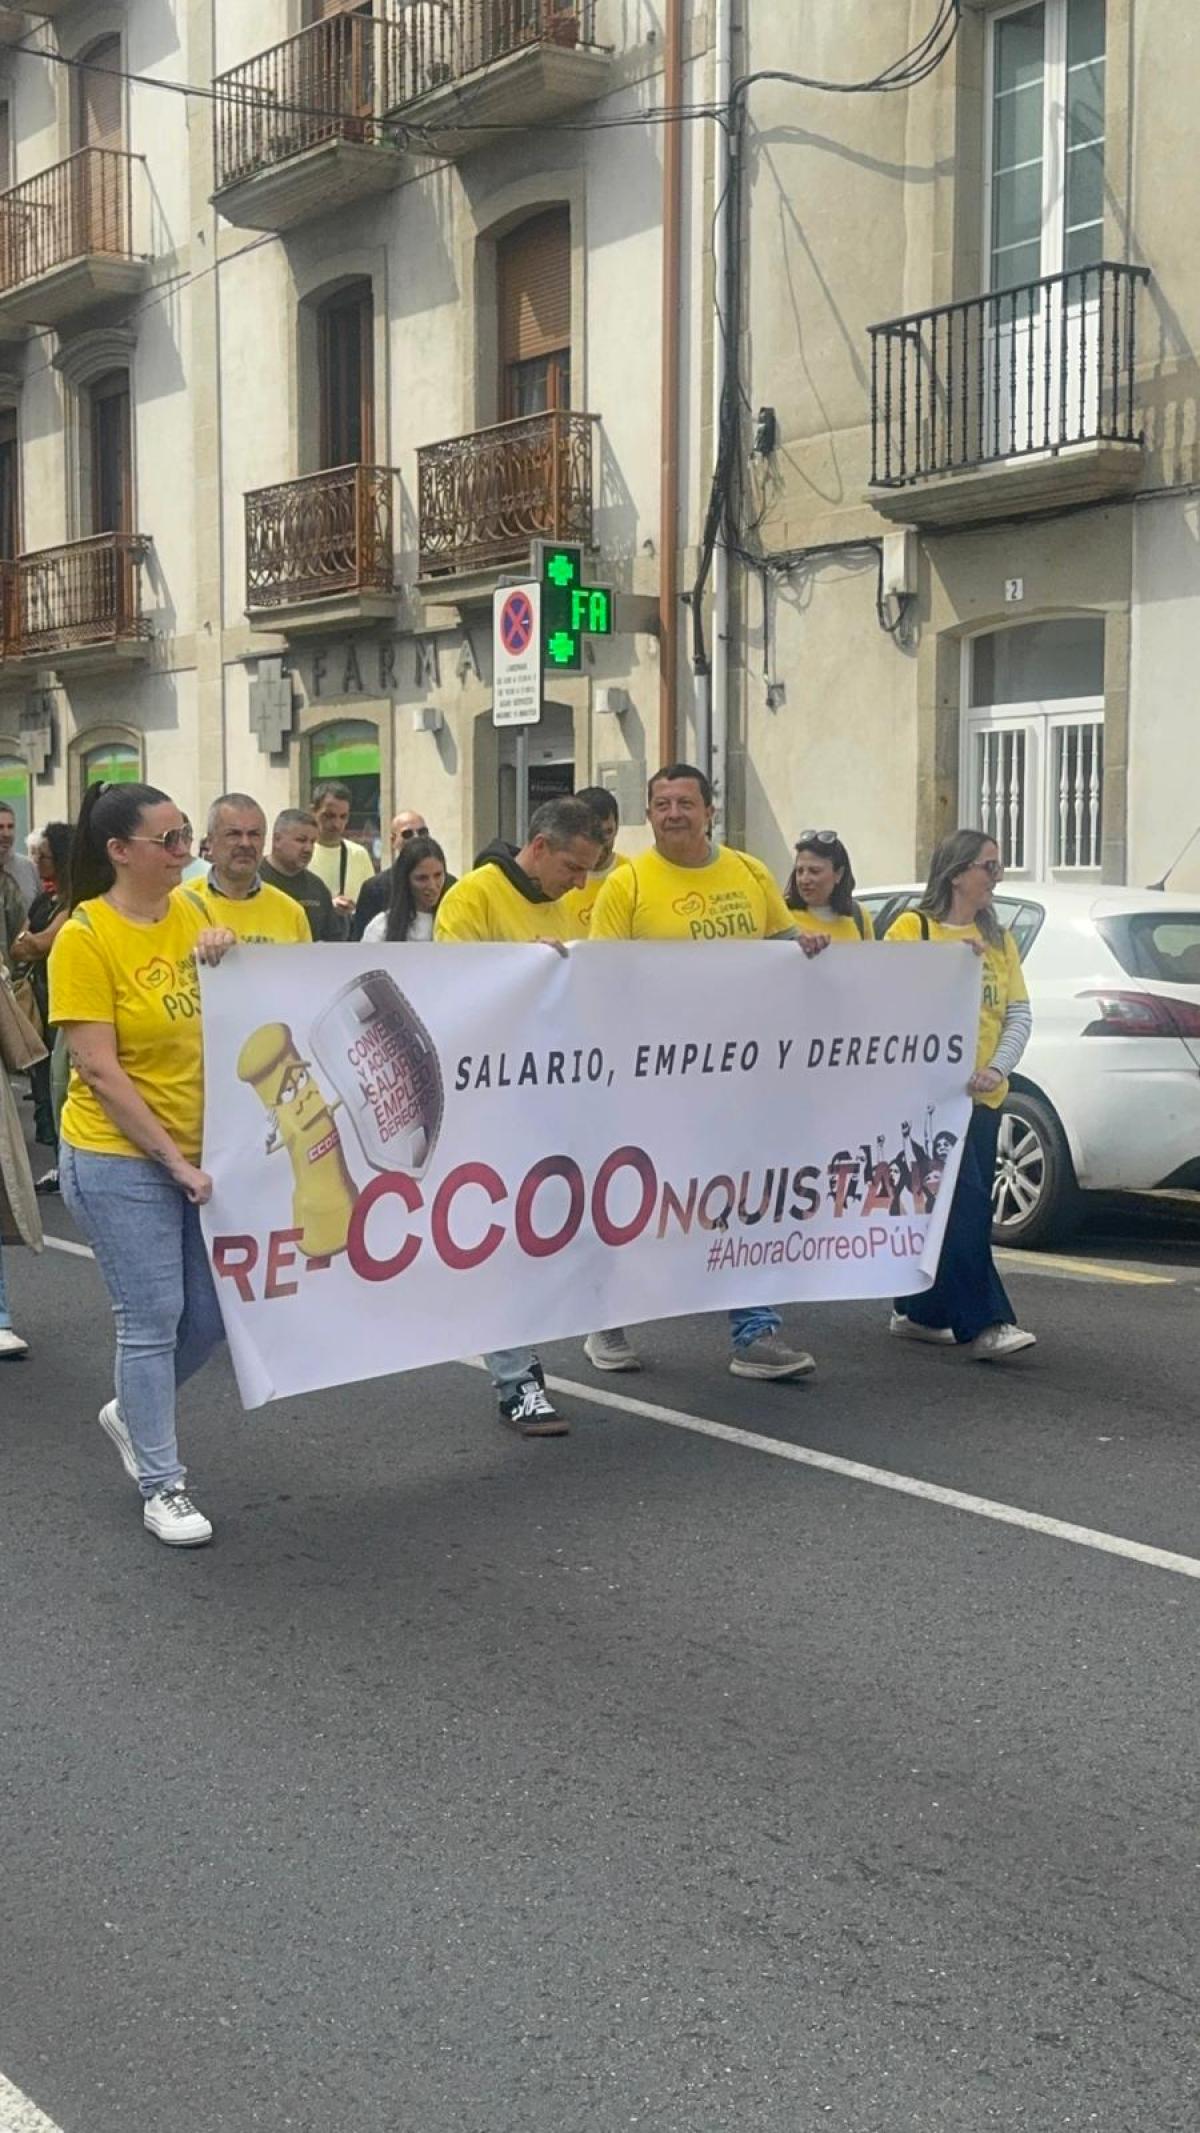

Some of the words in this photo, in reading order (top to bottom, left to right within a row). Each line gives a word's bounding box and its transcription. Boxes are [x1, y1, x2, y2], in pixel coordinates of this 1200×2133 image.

[571, 589, 608, 632] FA
[1011, 580, 1017, 600] 2
[689, 911, 757, 941] POSTAL
[455, 1047, 614, 1092] SALARIO,
[635, 1040, 759, 1078] EMPLEO
[778, 1039, 793, 1070] Y
[807, 1033, 963, 1069] DERECHOS
[706, 1222, 929, 1274] #AhoraCorreoPúb
